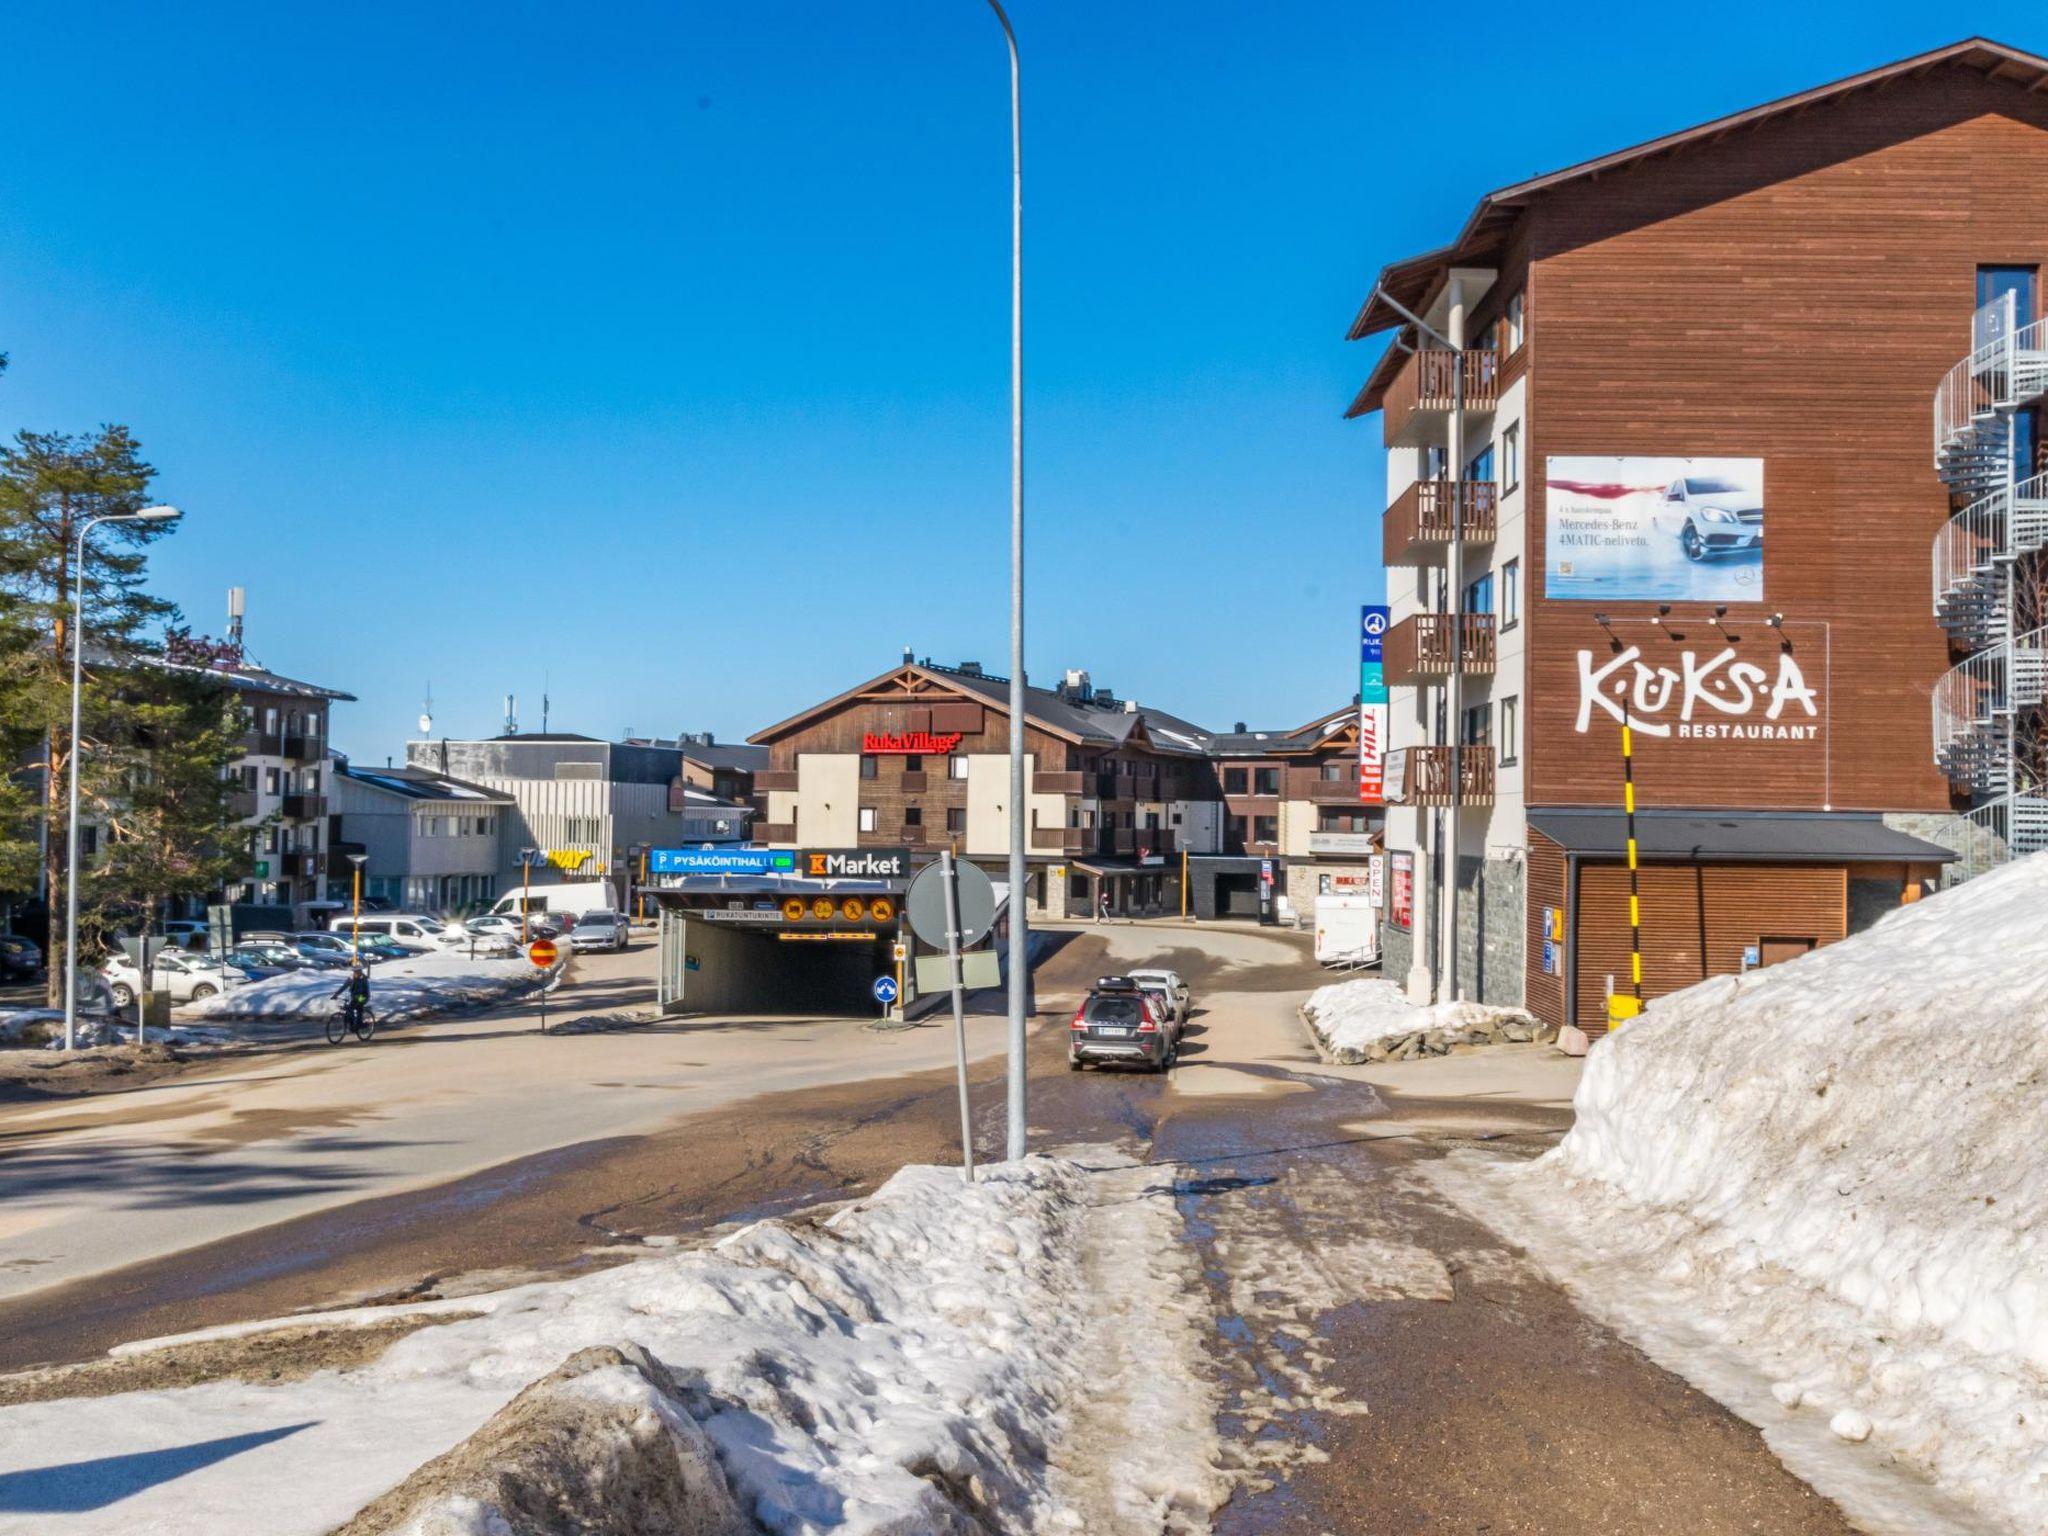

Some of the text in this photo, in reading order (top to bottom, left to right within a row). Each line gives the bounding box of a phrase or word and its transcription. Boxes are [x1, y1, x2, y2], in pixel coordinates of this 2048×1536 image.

[1559, 518, 1638, 530] Mercedes-Benz
[1363, 638, 1383, 646] RUK
[1364, 708, 1376, 760] HILL
[1679, 725, 1818, 739] RESTAURANT
[673, 855, 773, 867] PYSÄKÖINTIHALLI
[1372, 859, 1381, 897] OPEN
